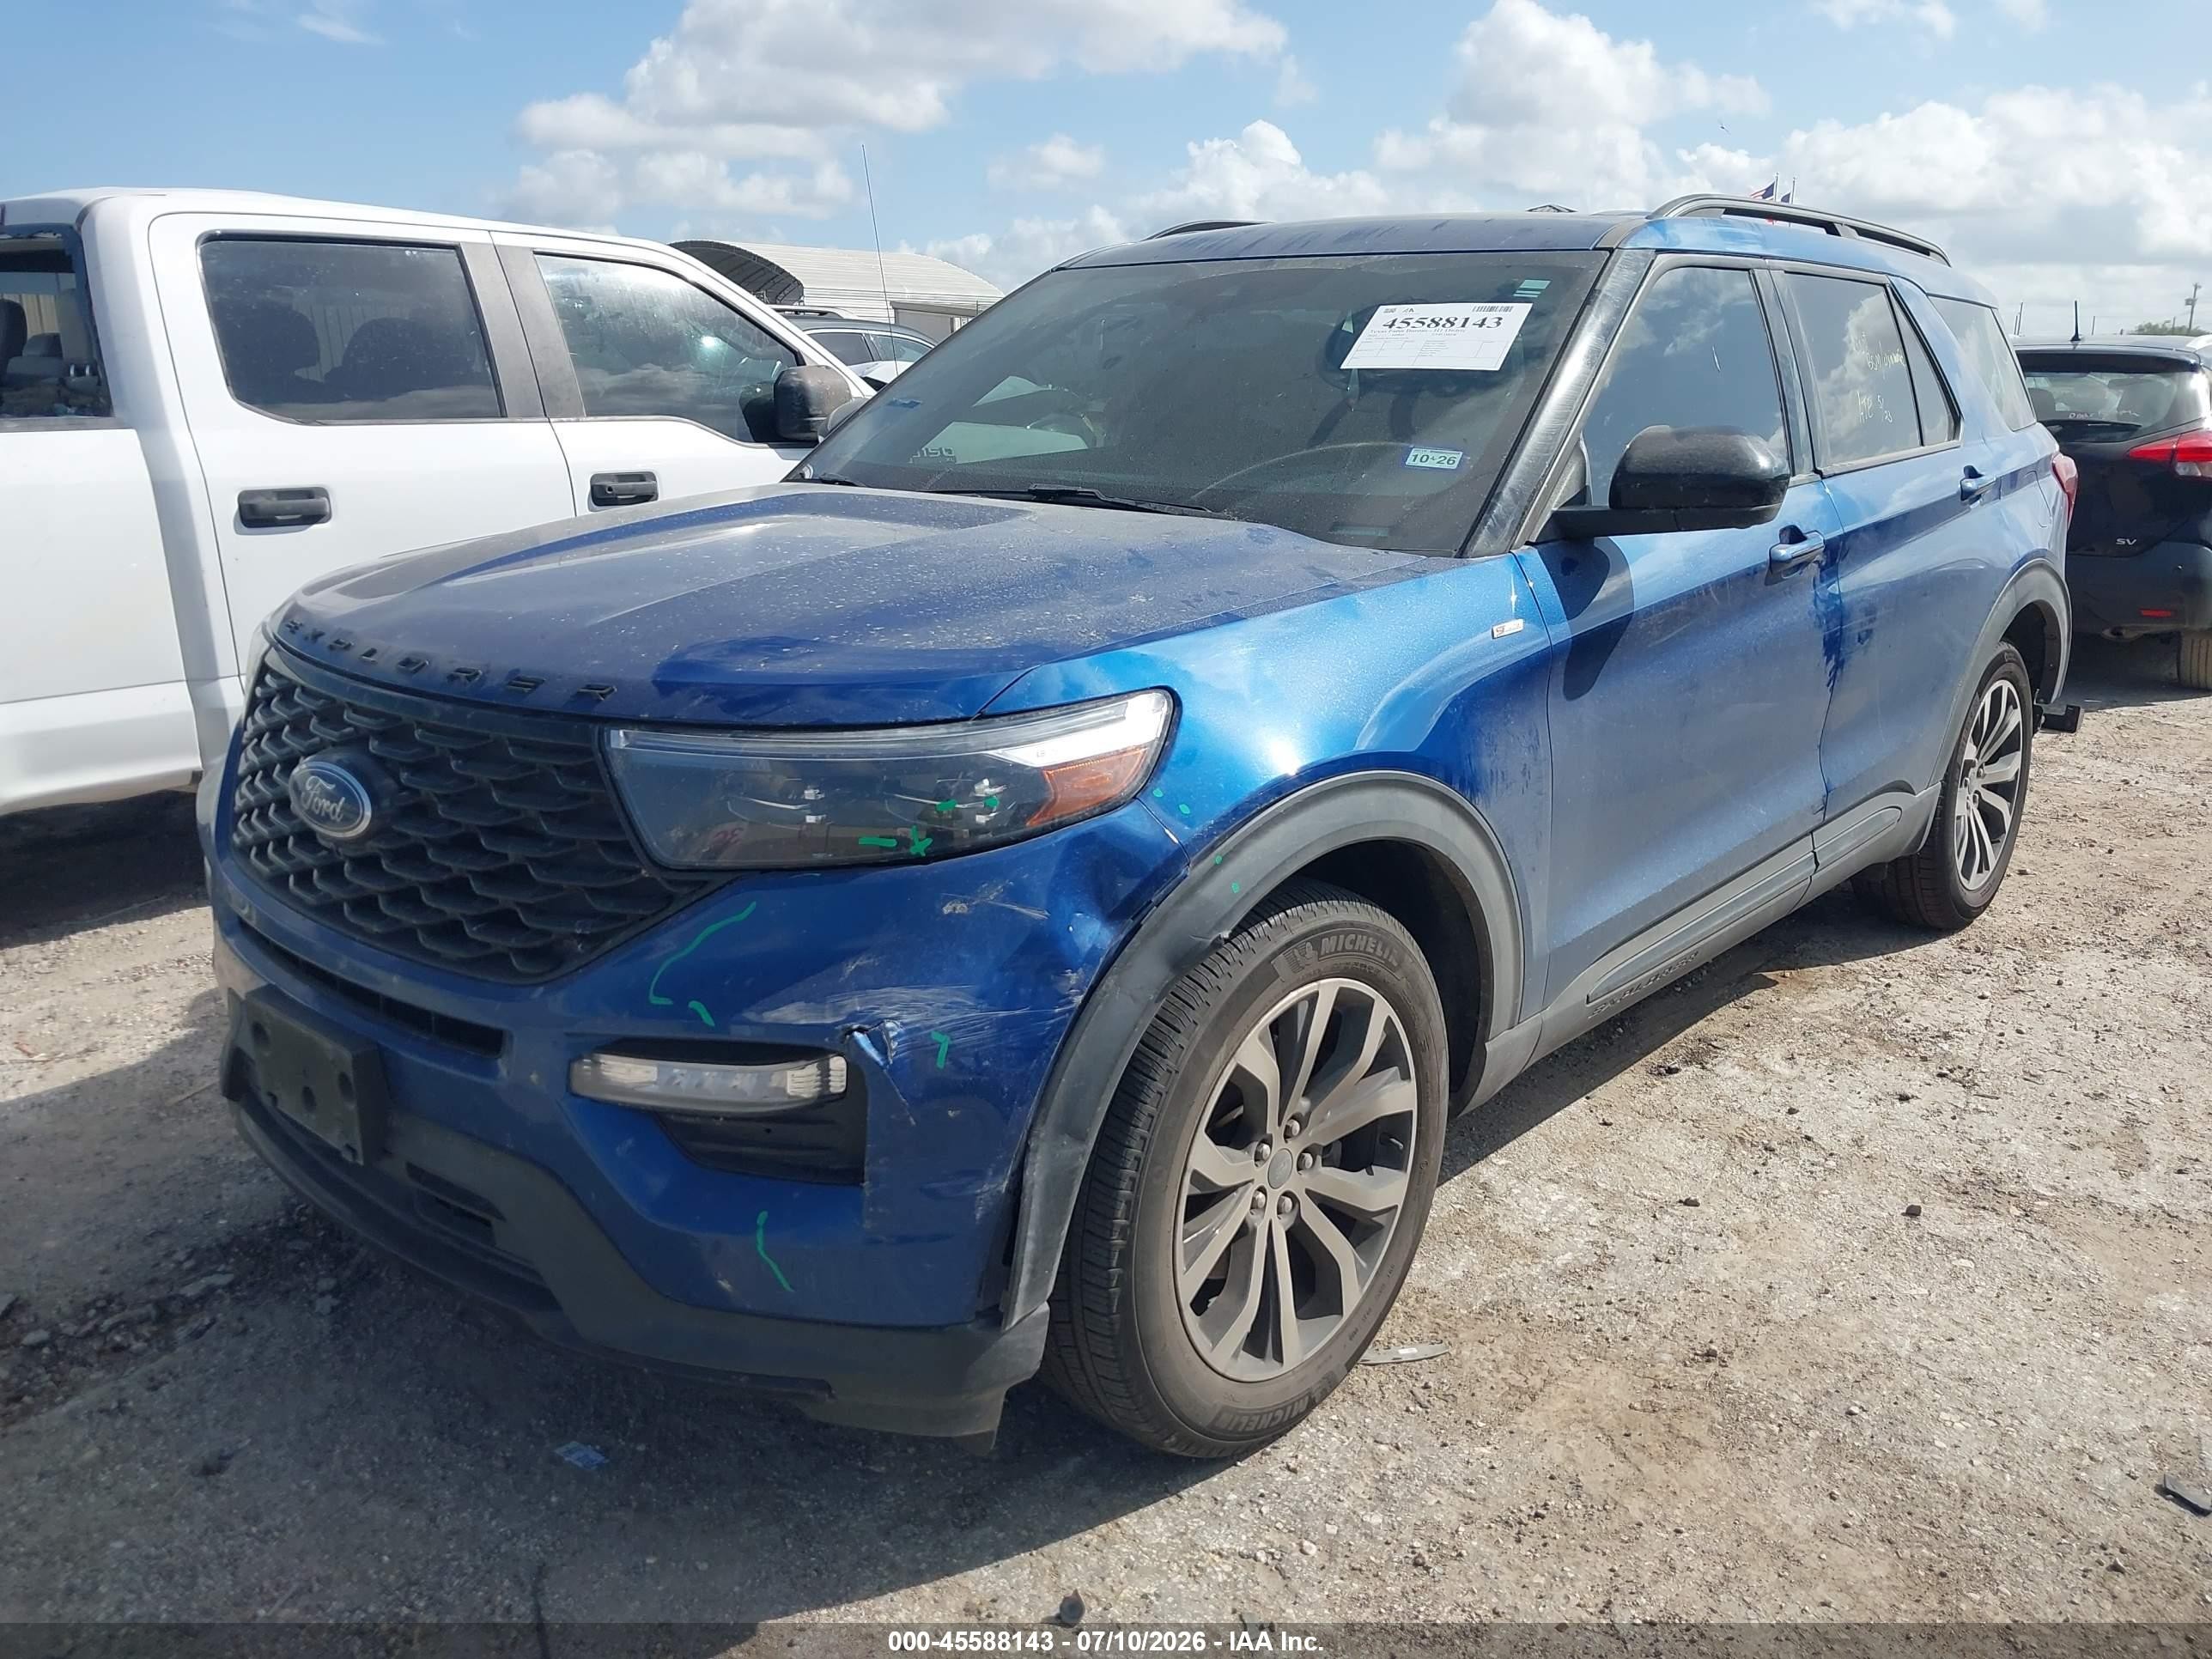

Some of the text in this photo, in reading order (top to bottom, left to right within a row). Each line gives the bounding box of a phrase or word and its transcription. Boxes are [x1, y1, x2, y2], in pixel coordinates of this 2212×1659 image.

[1382, 316, 1504, 329] 45588143
[284, 620, 618, 701] EXPLORER
[301, 775, 346, 823] Ford
[1320, 933, 1401, 967] MICHELIN
